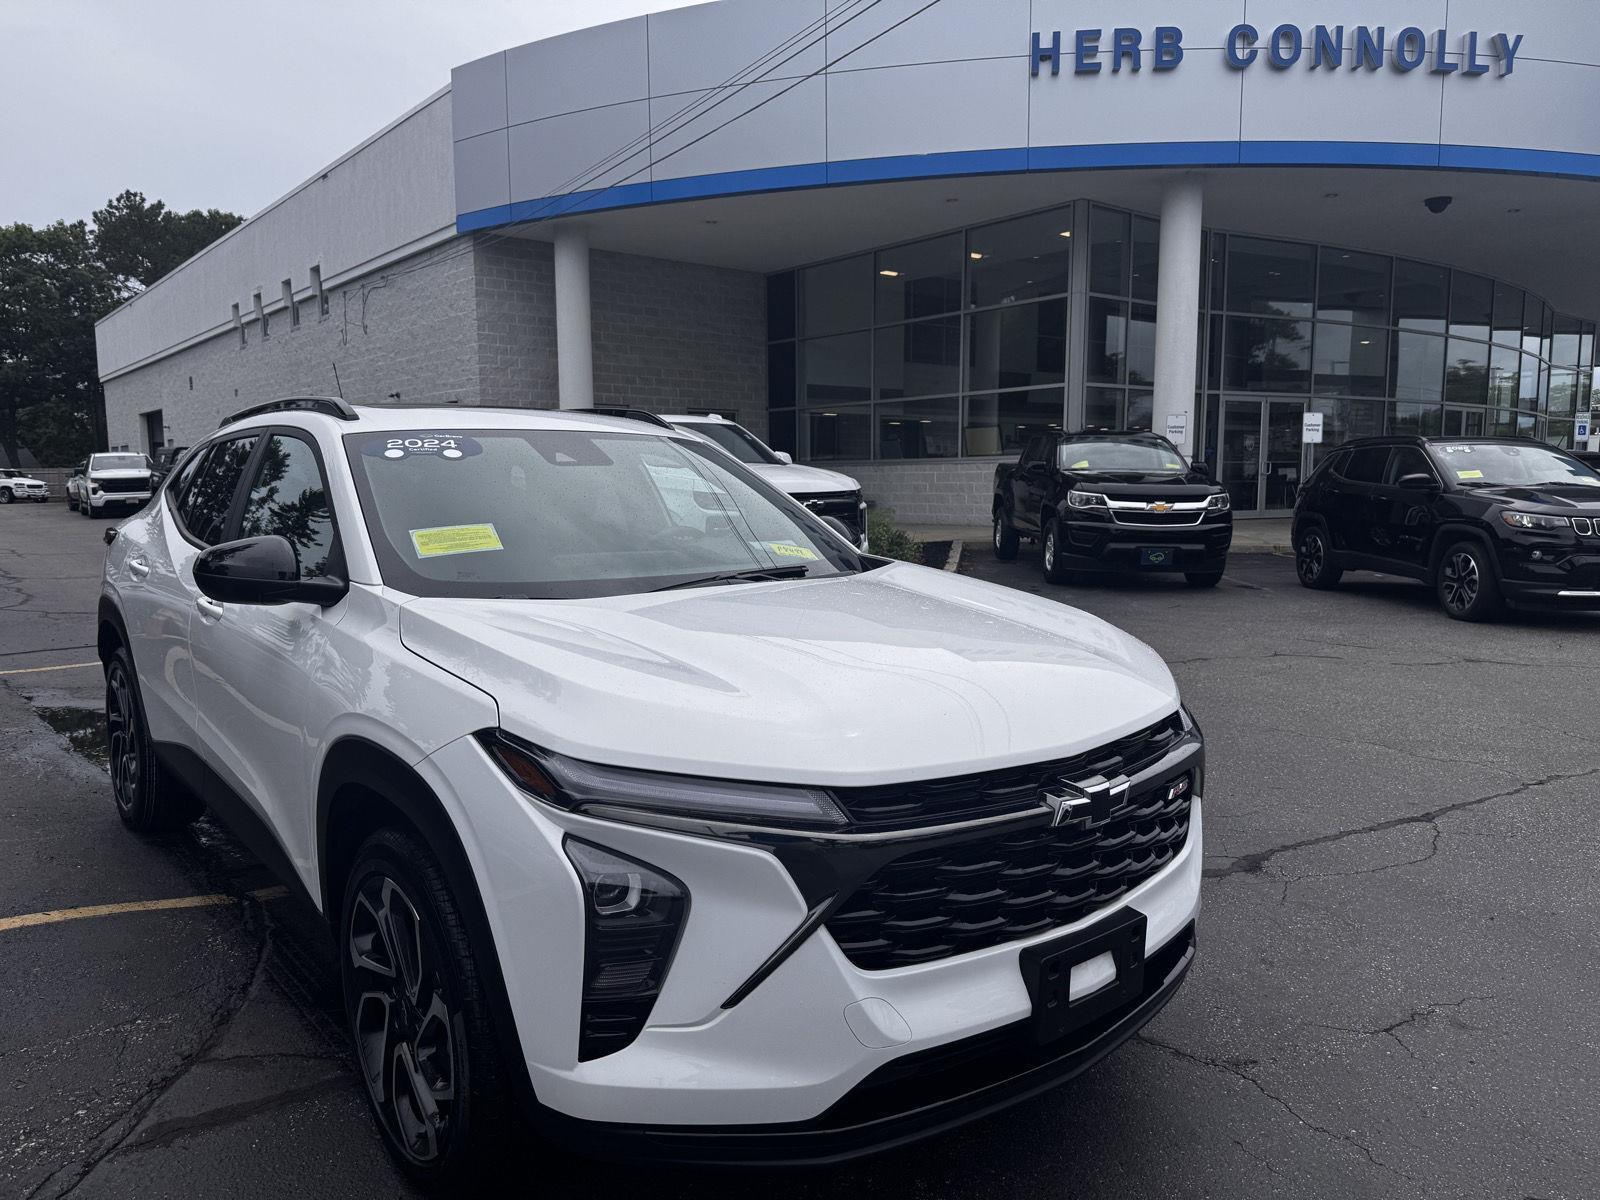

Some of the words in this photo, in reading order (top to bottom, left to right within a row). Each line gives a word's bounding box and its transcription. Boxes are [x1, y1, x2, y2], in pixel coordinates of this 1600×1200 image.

[1031, 26, 1184, 76] HERB
[1224, 24, 1524, 79] CONNOLLY
[387, 438, 457, 448] 2024
